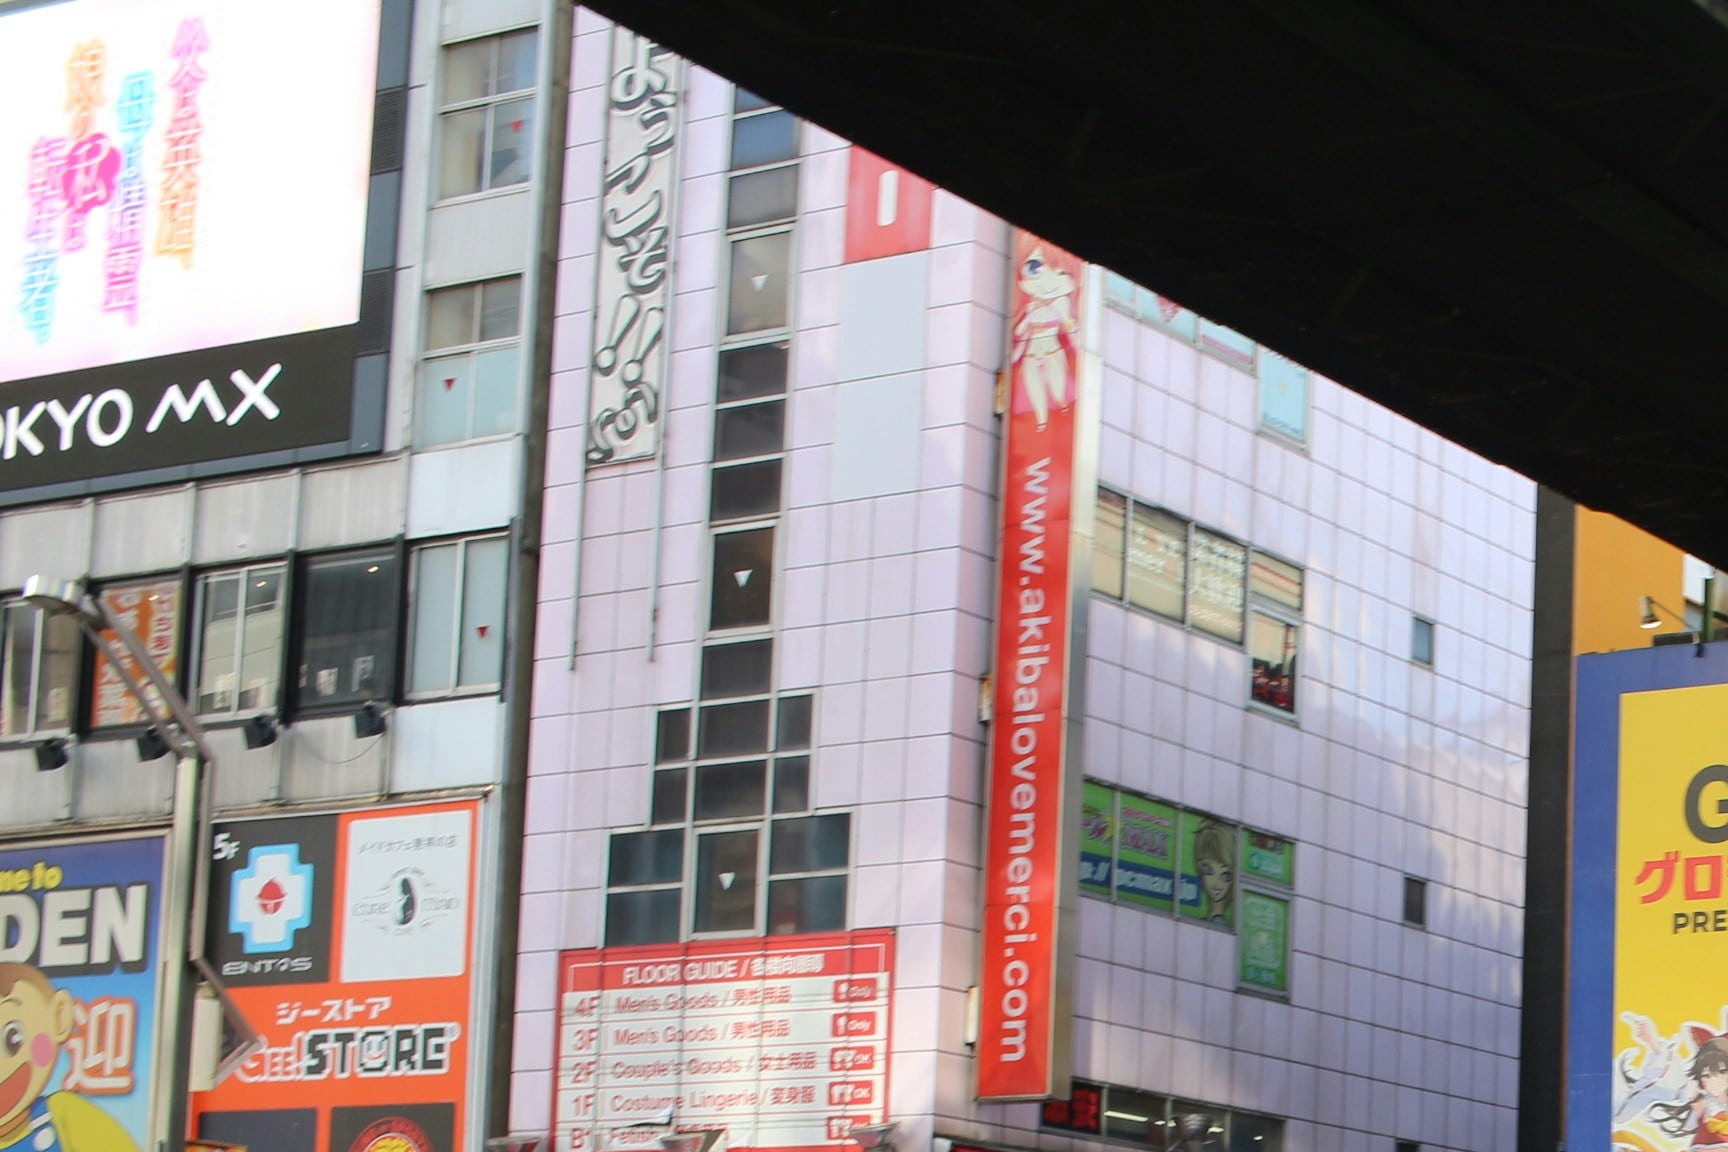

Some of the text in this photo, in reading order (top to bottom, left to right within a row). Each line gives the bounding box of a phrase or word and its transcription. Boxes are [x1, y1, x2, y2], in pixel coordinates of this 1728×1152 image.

[0, 364, 281, 459] KYO MX
[999, 456, 1052, 1064] www.akibalovemerci.com
[623, 964, 680, 985] FLOOR
[684, 960, 737, 981] GUIDE
[276, 996, 392, 1024] ジーストア
